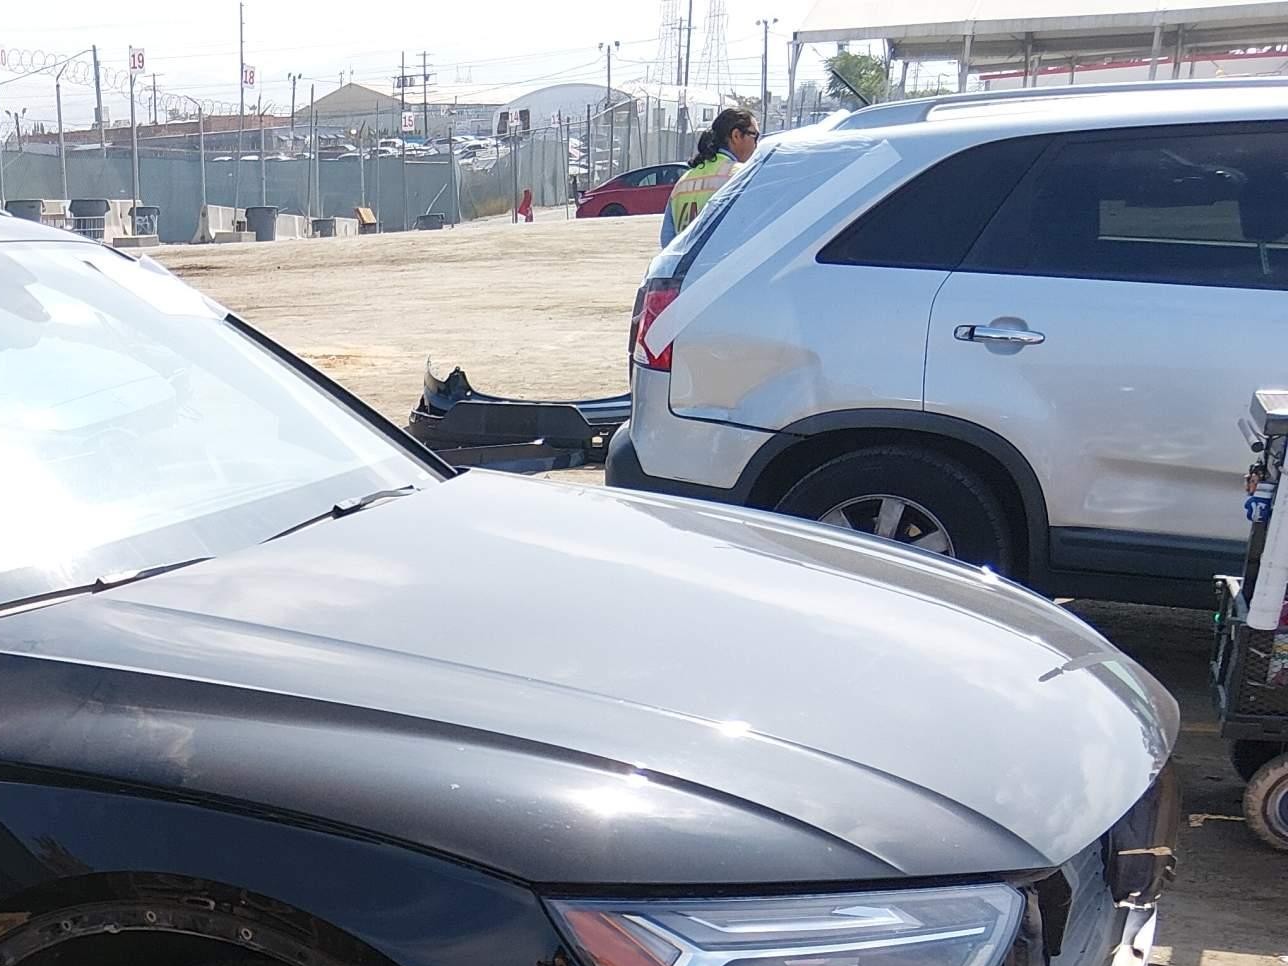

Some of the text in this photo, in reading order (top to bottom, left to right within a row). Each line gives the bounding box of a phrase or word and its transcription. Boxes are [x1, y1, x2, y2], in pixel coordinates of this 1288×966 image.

[131, 53, 145, 70] 19
[243, 69, 255, 85] 18
[402, 114, 414, 128] 15
